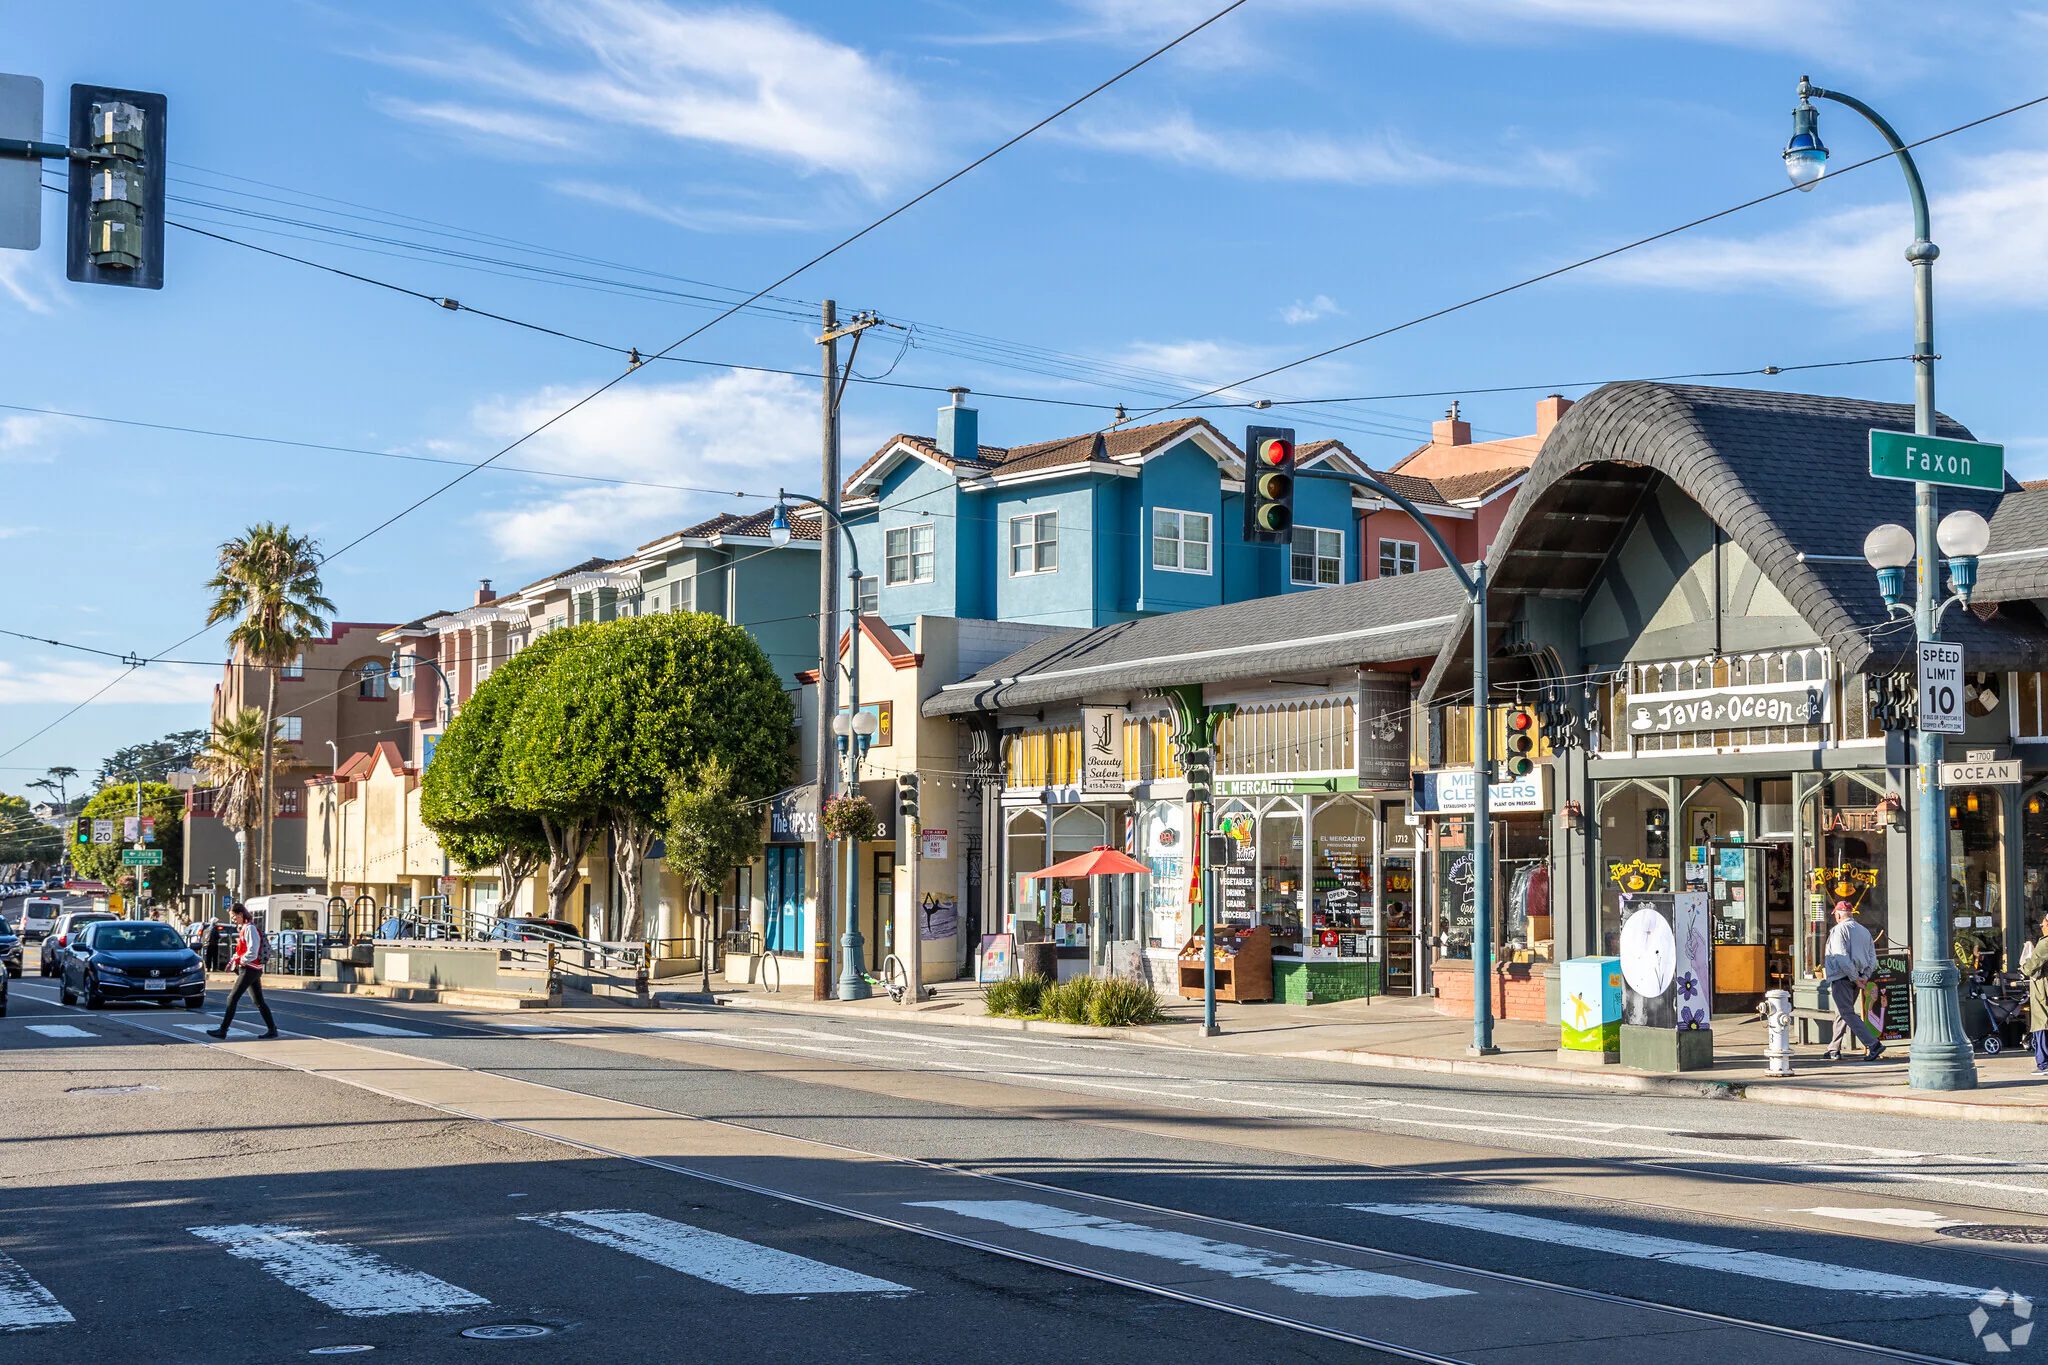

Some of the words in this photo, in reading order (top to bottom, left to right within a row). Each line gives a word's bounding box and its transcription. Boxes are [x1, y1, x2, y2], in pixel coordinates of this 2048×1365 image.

[1906, 446, 1971, 476] Faxon
[1923, 649, 1960, 663] SPEED
[1926, 667, 1956, 681] LIMIT
[1928, 685, 1955, 715] 10
[1655, 699, 1713, 731] Java
[1714, 704, 1726, 720] on
[1727, 695, 1795, 724] Ocean
[1795, 694, 1820, 720] cafe
[1087, 755, 1122, 768] Beauty
[1976, 752, 1991, 761] 1700
[1089, 767, 1119, 778] Salon
[1953, 765, 2009, 780] OCEAN
[1215, 781, 1229, 795] EL
[1231, 779, 1295, 795] MERCADITO
[1443, 785, 1536, 801] CLENERS
[772, 813, 788, 833] The
[789, 812, 806, 833] UPS
[95, 832, 111, 841] 20
[1394, 834, 1409, 844] 1712
[1226, 866, 1246, 875] FRUITS
[1219, 878, 1252, 886] VEGETABLES
[1850, 867, 1877, 888] Ocean
[1226, 888, 1246, 897] DRINKS
[1328, 890, 1345, 899] OPEN
[1226, 900, 1246, 908] GRAINS
[1221, 910, 1251, 919] GROCERIES
[1887, 957, 1907, 973] OCEAN
